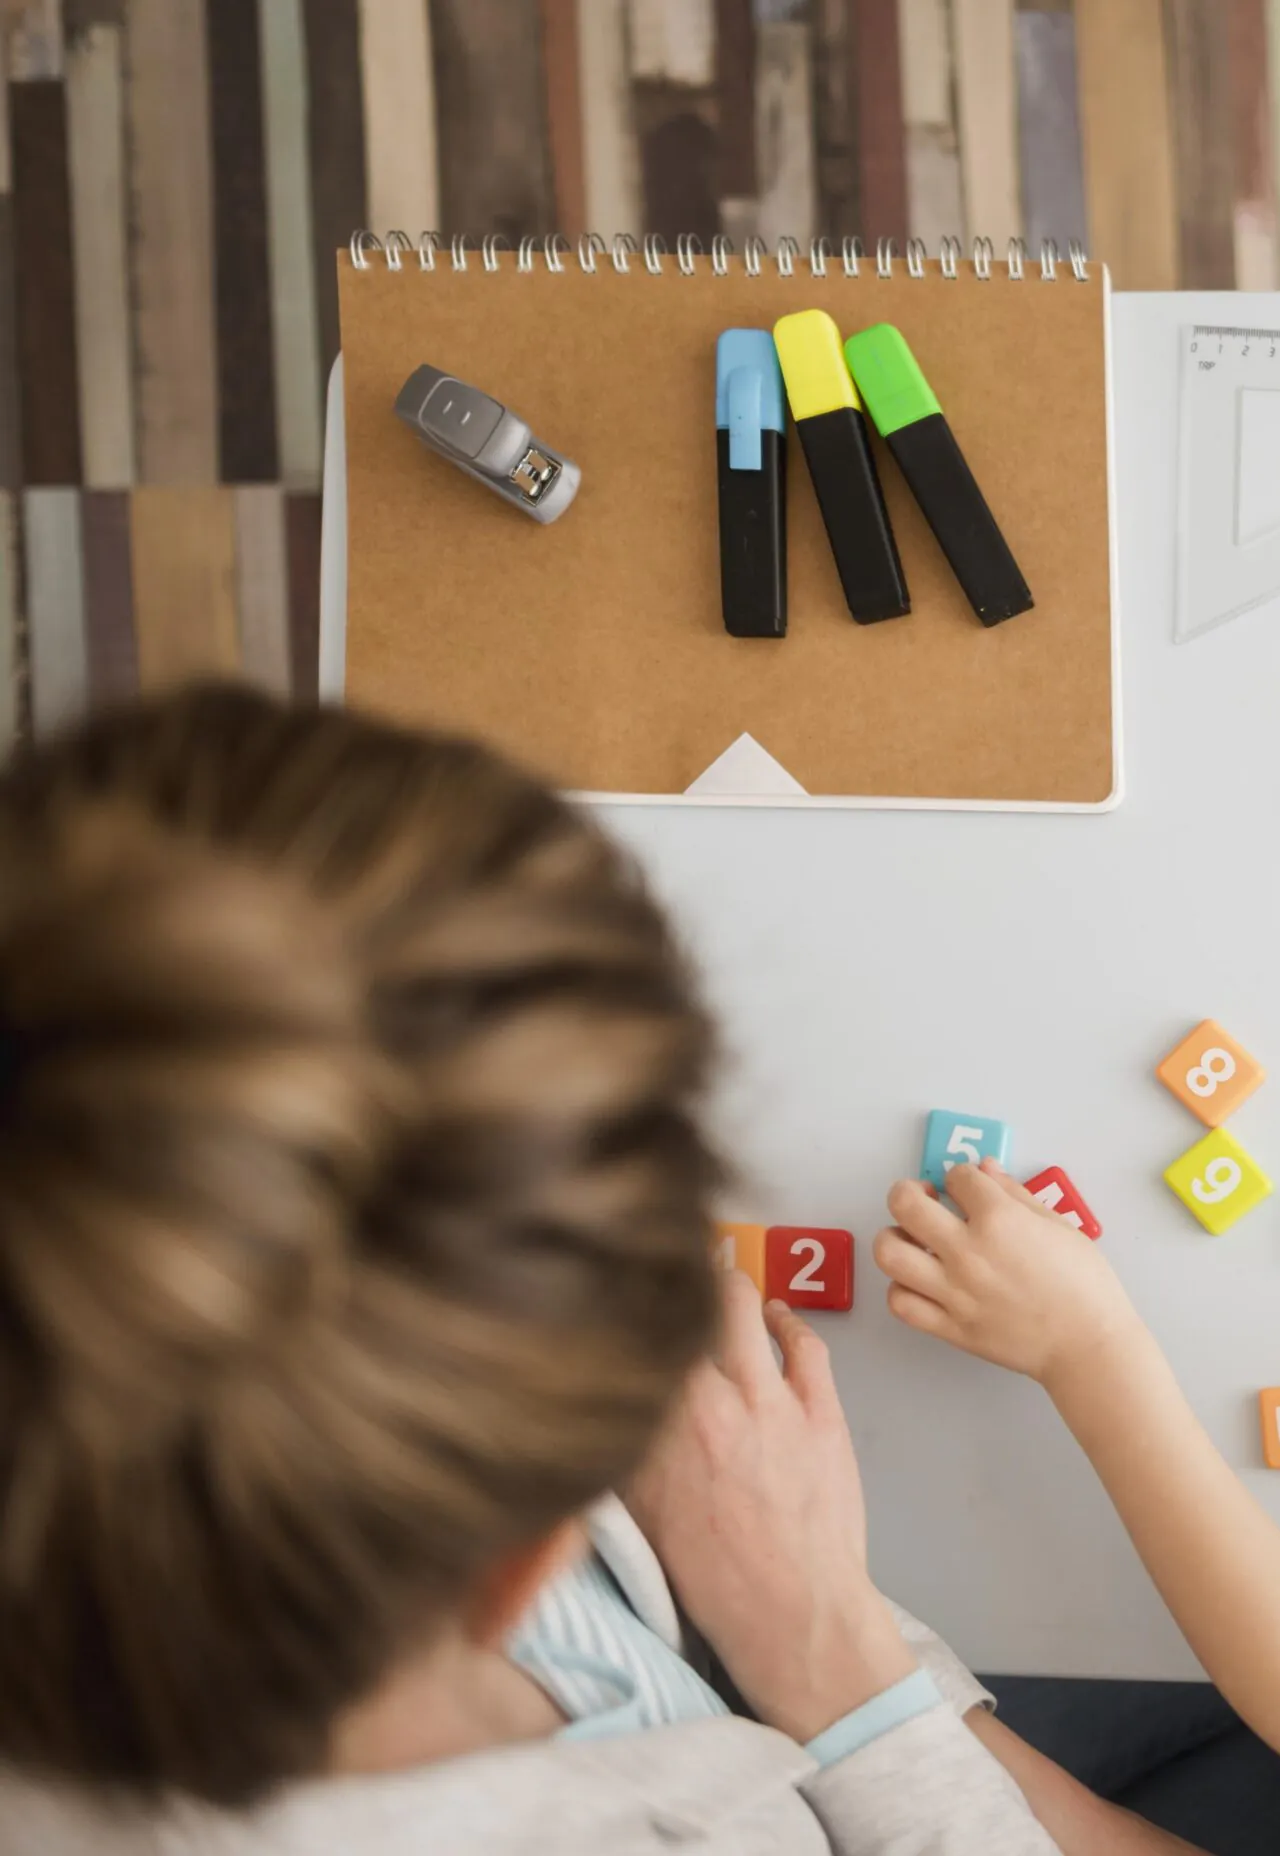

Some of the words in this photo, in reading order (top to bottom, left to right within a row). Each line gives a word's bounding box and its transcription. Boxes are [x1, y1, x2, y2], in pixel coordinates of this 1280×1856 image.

[1186, 1047, 1236, 1098] 8
[942, 1124, 984, 1173] 5
[789, 1237, 826, 1291] 2
